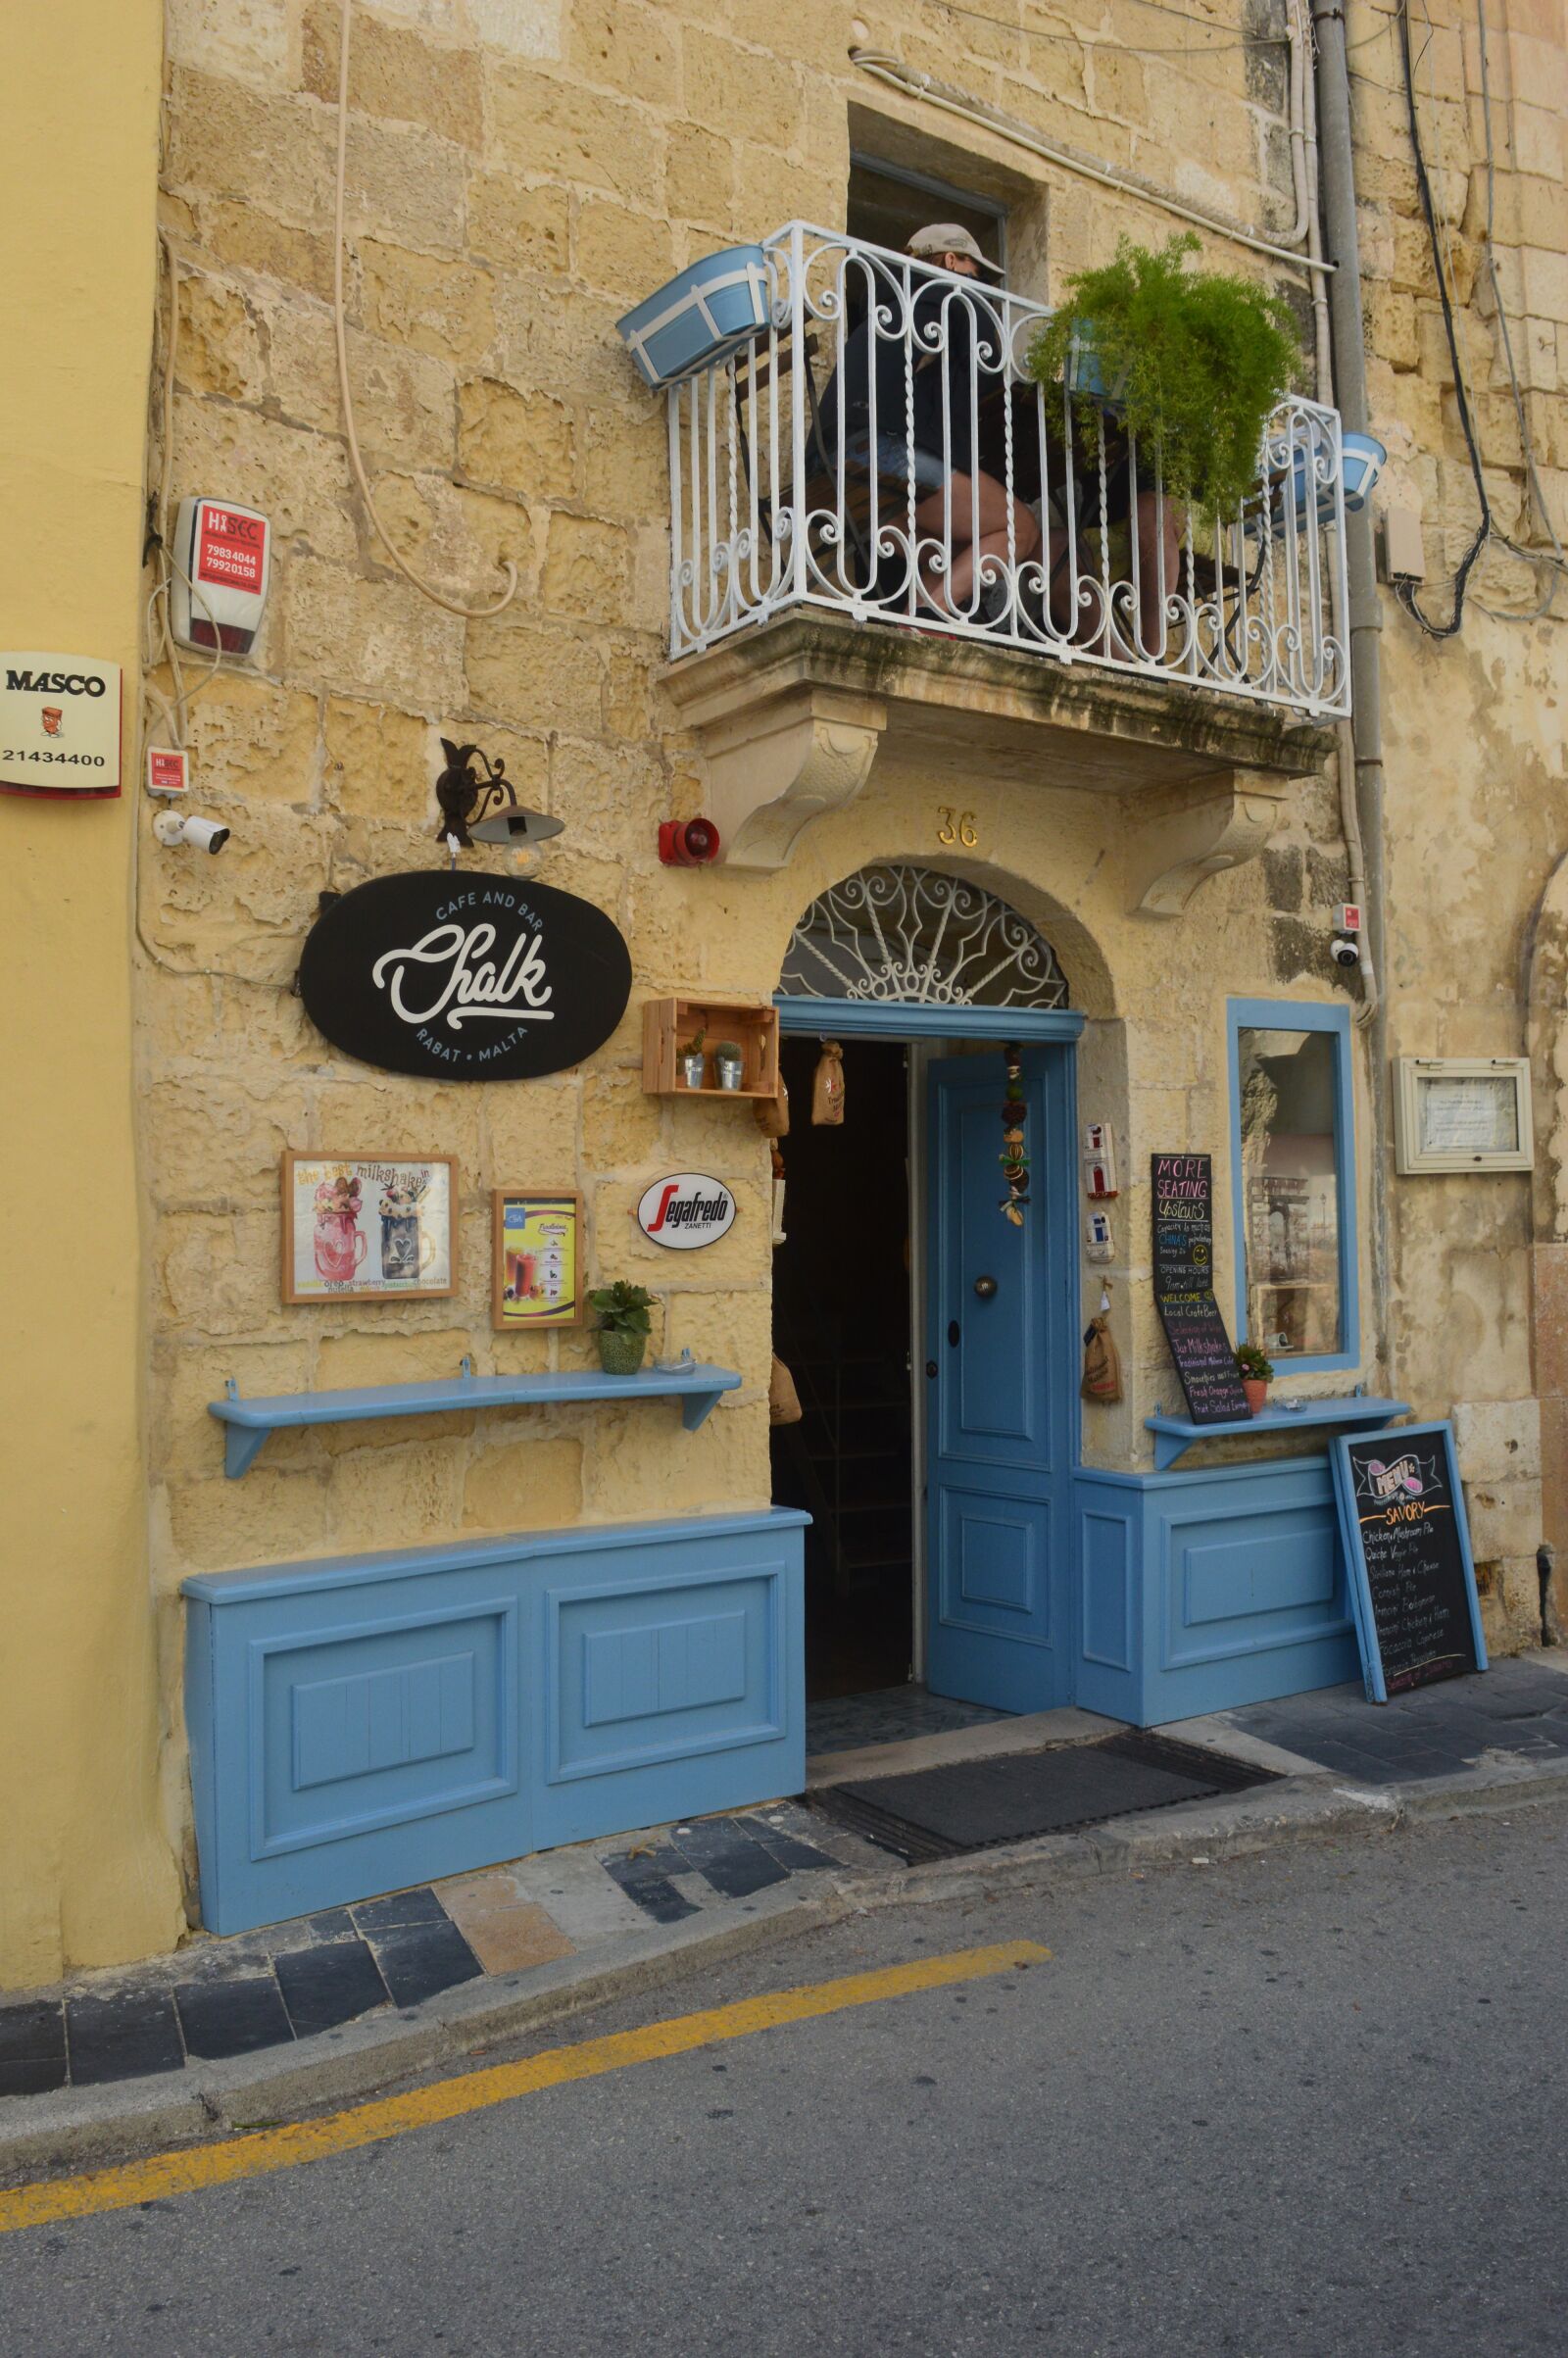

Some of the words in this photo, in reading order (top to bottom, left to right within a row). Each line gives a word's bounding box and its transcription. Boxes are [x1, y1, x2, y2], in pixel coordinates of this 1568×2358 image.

[207, 544, 257, 565] 79834044
[206, 557, 256, 578] 79920158
[6, 669, 106, 697] MASCO
[2, 750, 105, 766] 21434400
[937, 806, 978, 848] 36
[436, 892, 476, 920] CAFE
[482, 891, 515, 908] AND
[517, 904, 543, 931] BAR
[372, 923, 553, 1024] Chalk
[416, 1028, 462, 1062] RABAT
[479, 1026, 528, 1061] MALTA
[357, 1163, 422, 1188] milkshake
[1157, 1159, 1208, 1179] MORE
[1156, 1180, 1208, 1198] SEATING
[647, 1184, 728, 1232] Segafredo
[1160, 1266, 1187, 1275] OPENING
[1188, 1266, 1209, 1275] HOURS
[349, 1278, 385, 1287] strawberry
[1160, 1293, 1200, 1302] WELCOME
[1164, 1305, 1183, 1316] Local
[1189, 1386, 1207, 1398] Fresh
[1376, 1460, 1409, 1495] MENU
[1386, 1500, 1426, 1525] SAVORY
